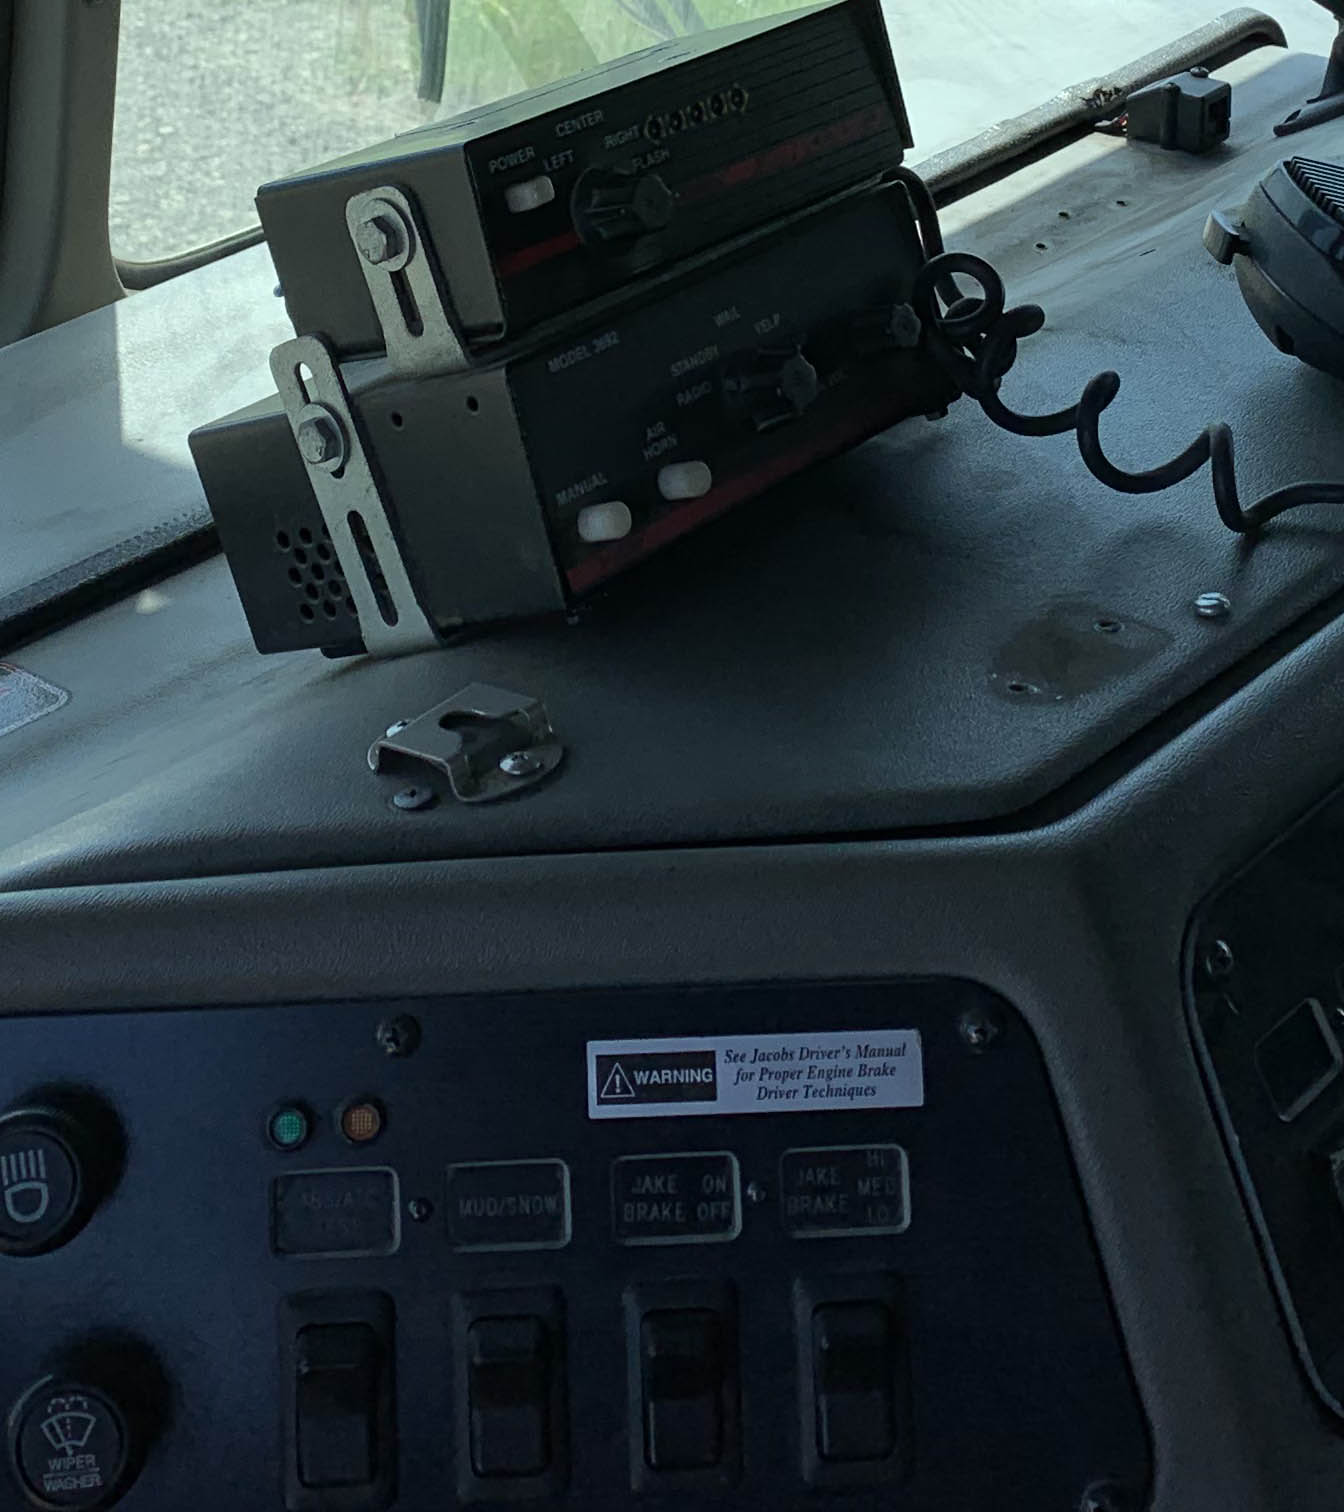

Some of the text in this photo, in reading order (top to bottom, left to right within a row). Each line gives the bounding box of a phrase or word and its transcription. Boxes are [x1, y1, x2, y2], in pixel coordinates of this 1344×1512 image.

[555, 109, 606, 138] CENTER
[602, 125, 641, 151] RIGHT
[487, 145, 536, 175] POWER
[542, 148, 576, 173] LEFT
[632, 148, 671, 170] FLASH
[547, 345, 592, 373] MODEL
[555, 472, 609, 506] MANUAL
[724, 1042, 907, 1065] See Jacobs Driver's Manual
[632, 1068, 714, 1085] WARNING
[734, 1062, 897, 1086] for Proper Engine Brake
[756, 1082, 878, 1102] Driver Techniques
[631, 1173, 727, 1195] JAKE ON
[797, 1165, 841, 1187] JAKE
[457, 1193, 563, 1218] MUD/SNOW
[623, 1200, 733, 1224] BRAKE OFF
[787, 1193, 850, 1217] BRAKE
[47, 1453, 97, 1472] WIPER
